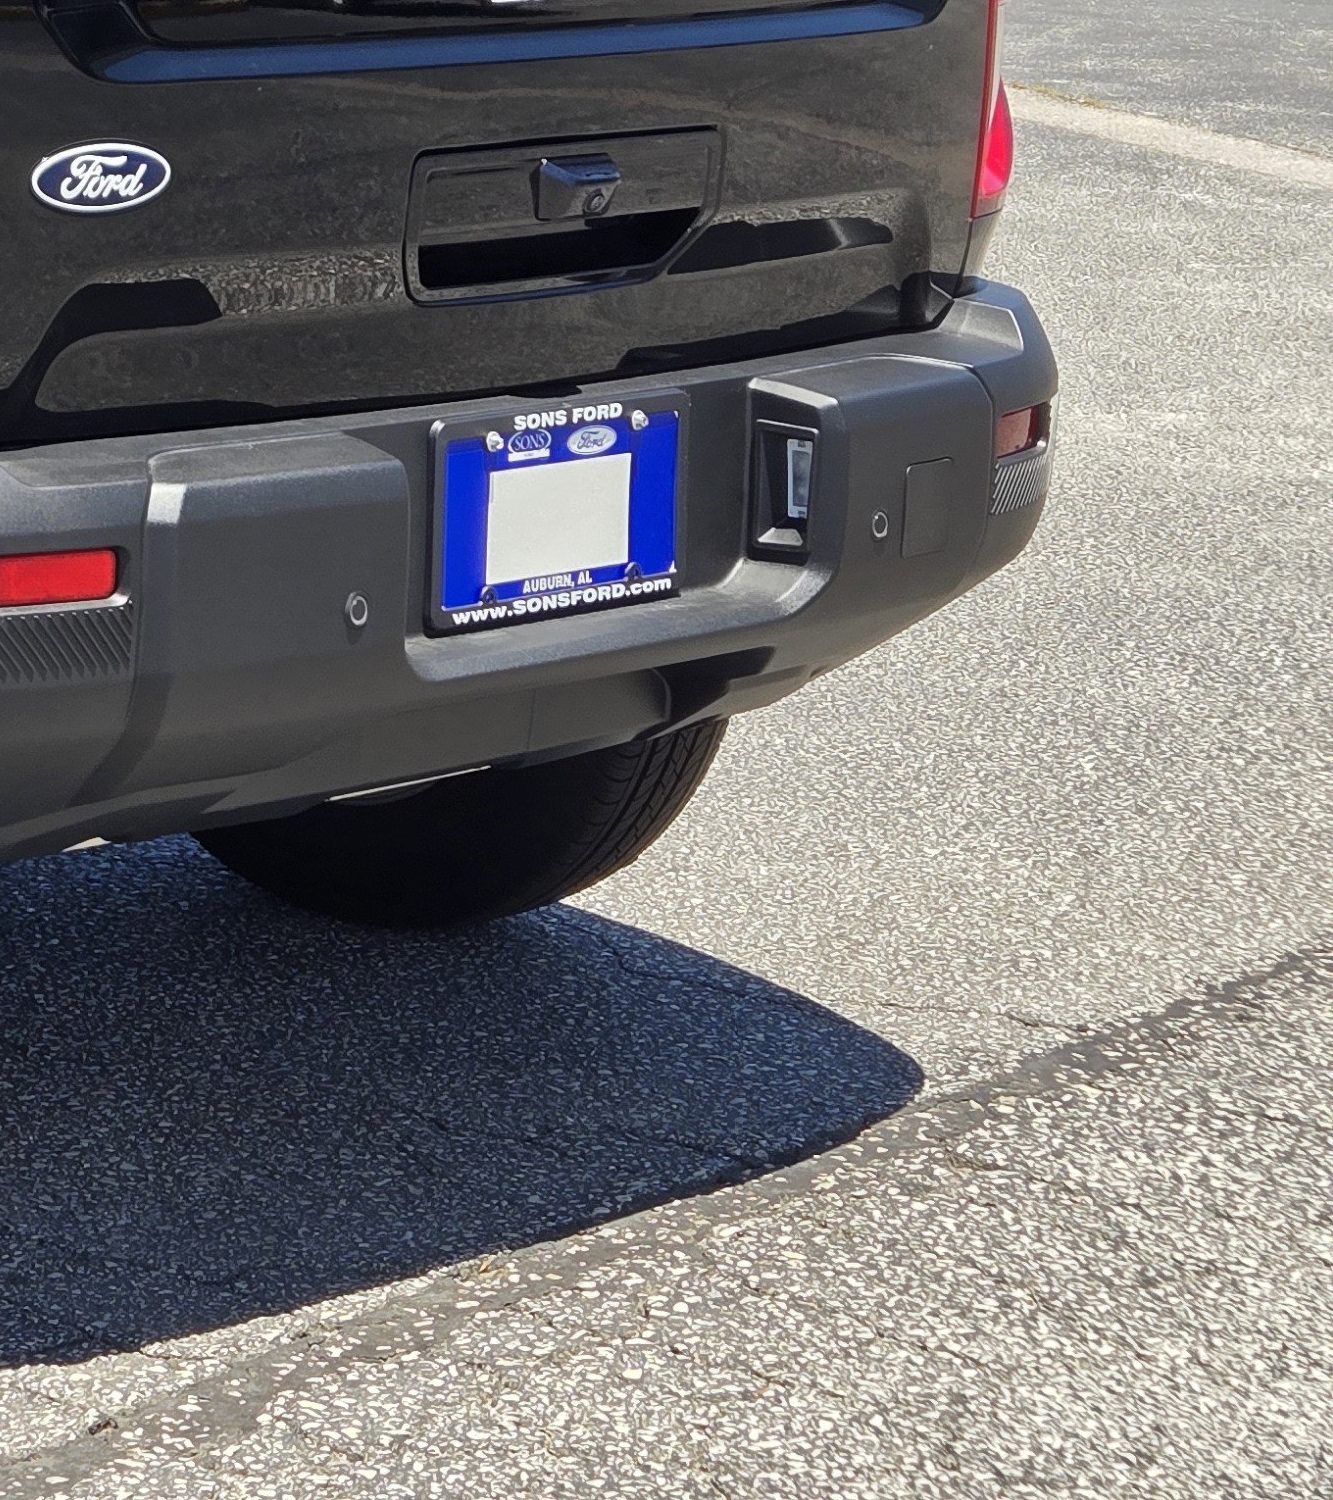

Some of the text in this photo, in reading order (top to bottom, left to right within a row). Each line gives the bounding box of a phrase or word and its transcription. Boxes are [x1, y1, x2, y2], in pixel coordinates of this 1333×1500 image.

[60, 154, 147, 200] Ford
[513, 403, 622, 430] SONS FORD
[514, 432, 545, 451] SONS
[576, 431, 607, 449] Ford
[523, 570, 593, 594] AUBURN, AL
[452, 577, 672, 625] www.SONSFORD.com
